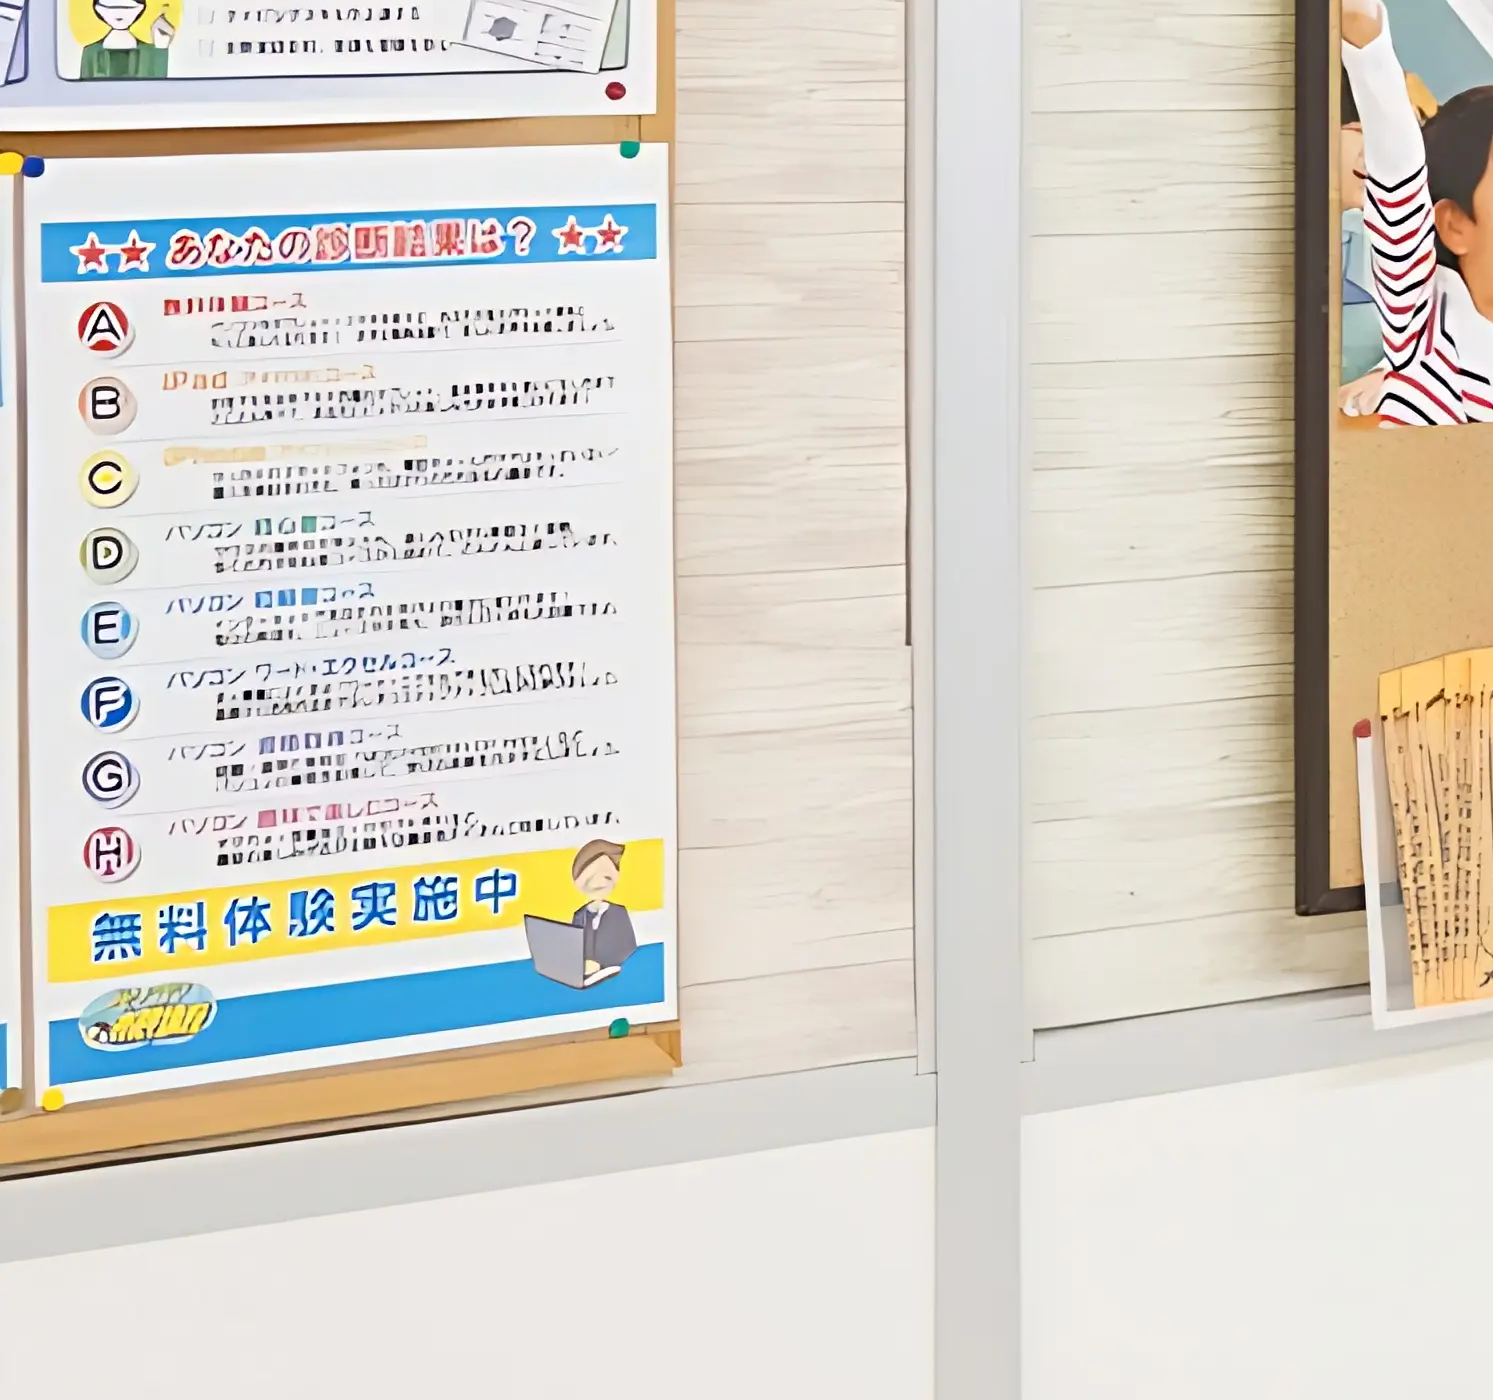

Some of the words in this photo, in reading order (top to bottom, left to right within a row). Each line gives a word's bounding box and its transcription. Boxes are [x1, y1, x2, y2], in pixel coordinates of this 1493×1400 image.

[91, 867, 519, 963] 無料体験実施中
